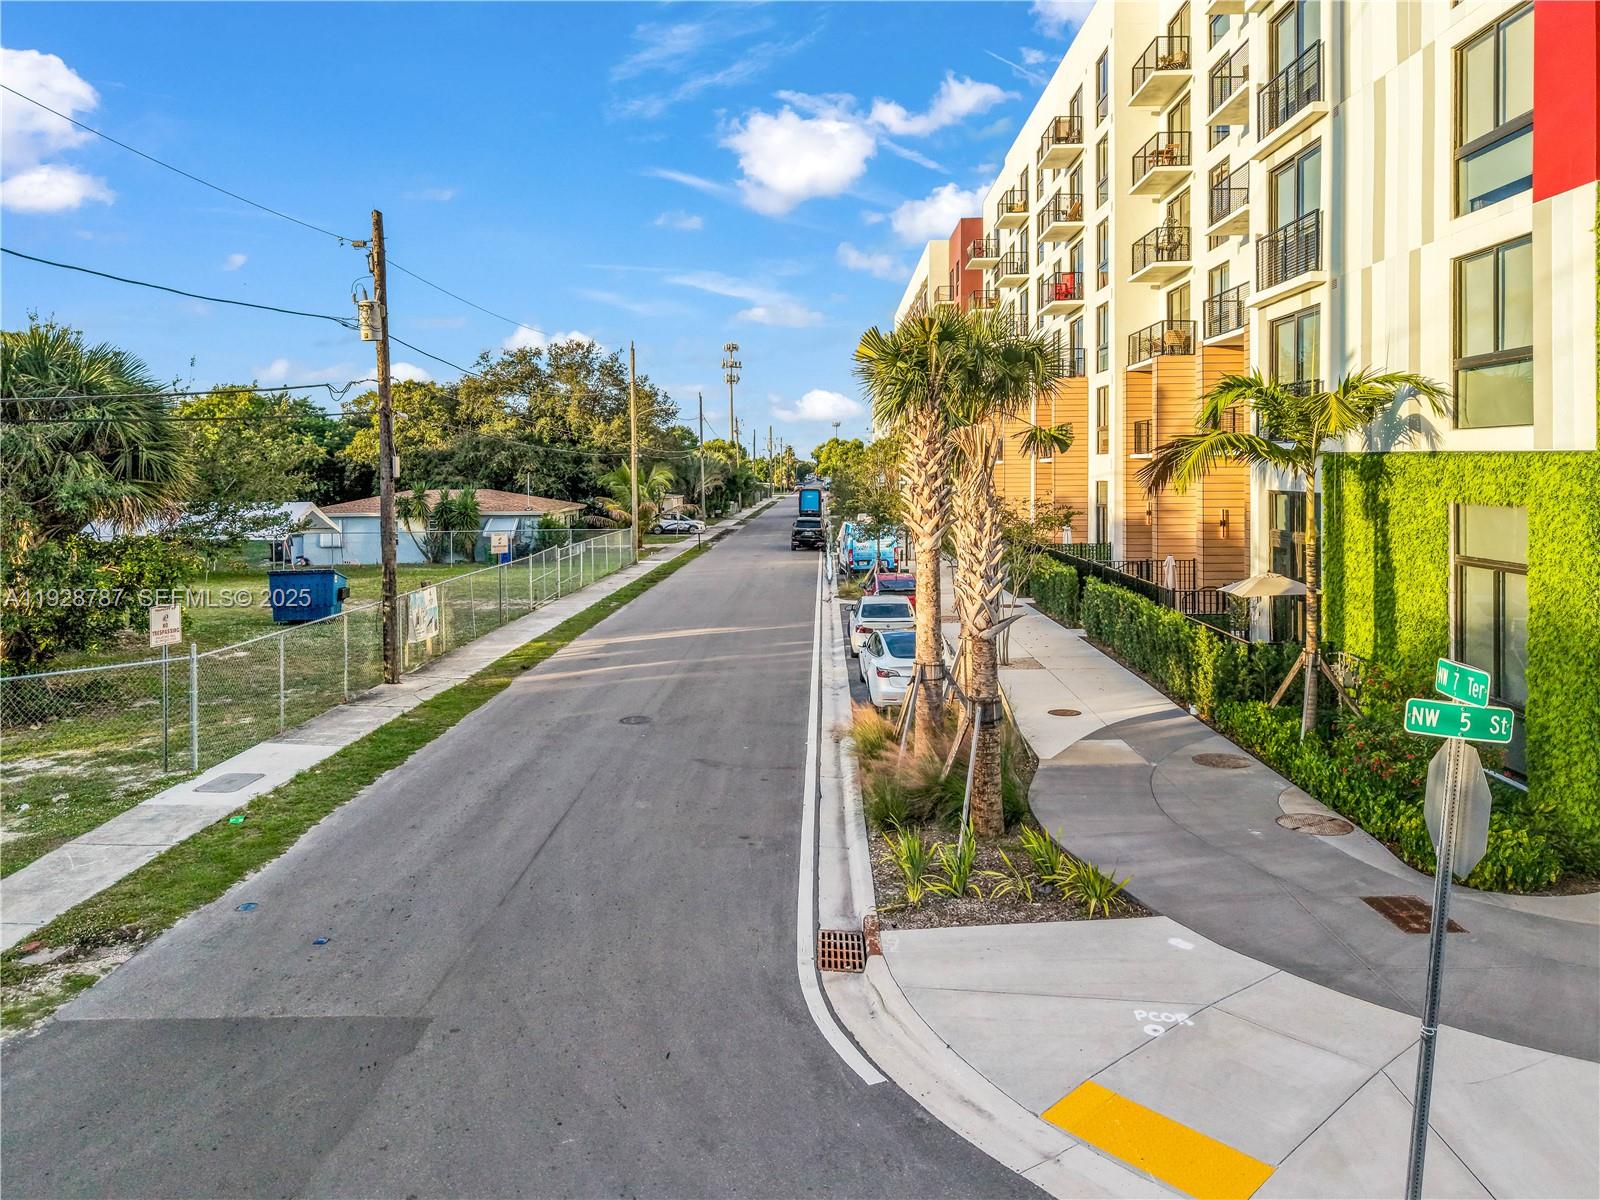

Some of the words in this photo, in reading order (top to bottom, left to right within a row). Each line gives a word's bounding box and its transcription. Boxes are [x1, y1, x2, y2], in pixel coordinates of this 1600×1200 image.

[1438, 666, 1449, 687] NW
[1453, 672, 1459, 691] 7
[1467, 676, 1485, 699] Ter
[1411, 706, 1440, 728] NW
[1460, 712, 1471, 732] 5
[1489, 715, 1508, 735] St
